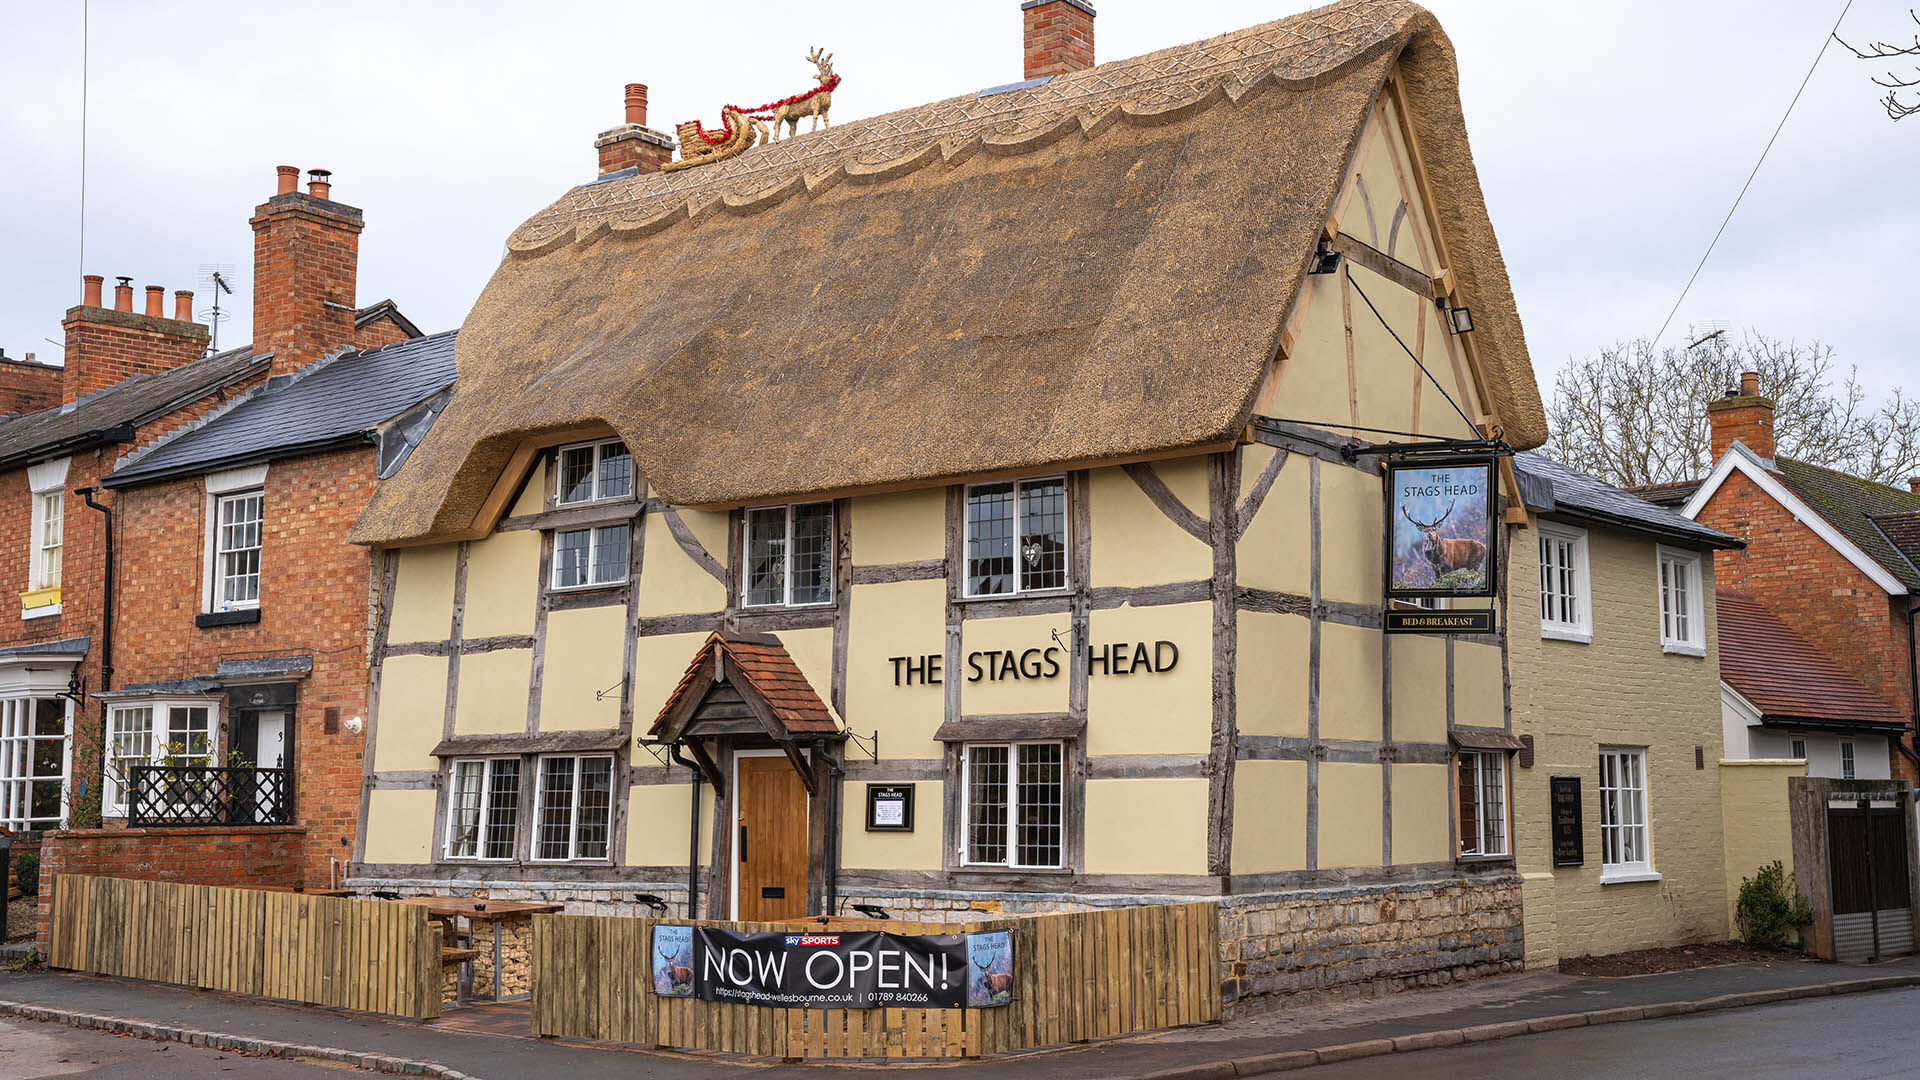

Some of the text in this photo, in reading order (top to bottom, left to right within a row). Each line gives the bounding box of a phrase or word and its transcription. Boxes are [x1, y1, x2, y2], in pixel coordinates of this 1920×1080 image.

[1432, 474, 1450, 483] THE
[1404, 484, 1478, 497] STAGS HEAD
[888, 640, 1179, 686] THE STAGS HEAD
[786, 936, 839, 945] sky SPORTS
[703, 945, 948, 990] NOW OPEN!
[868, 992, 894, 1002] 01789
[895, 992, 929, 1002] 840266
